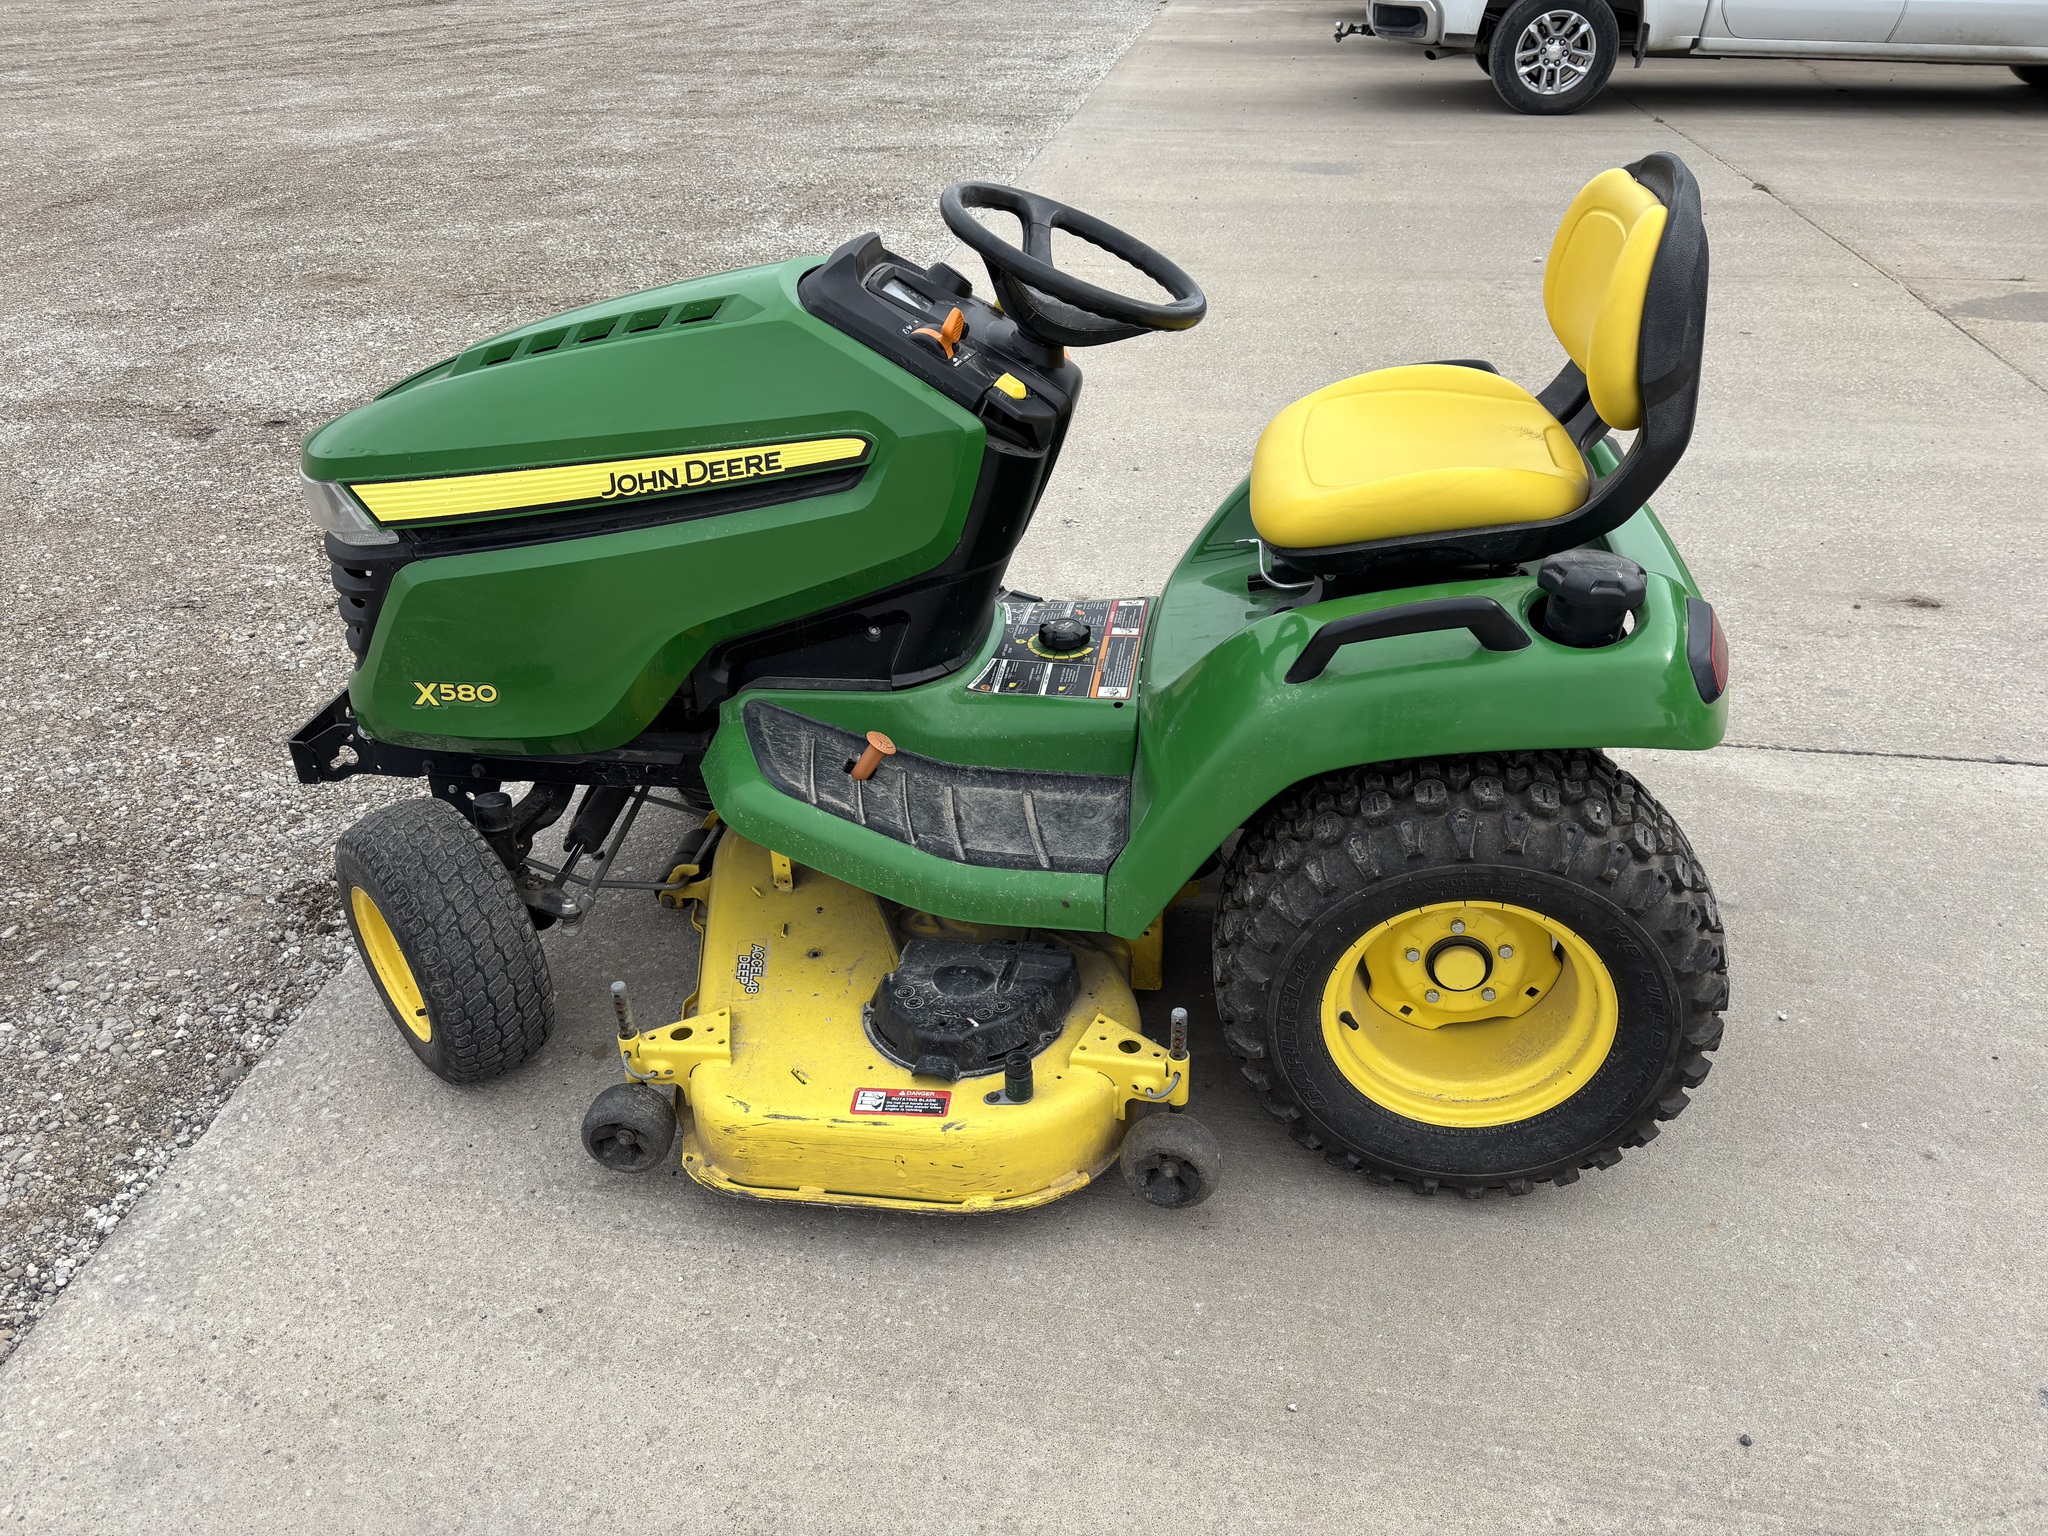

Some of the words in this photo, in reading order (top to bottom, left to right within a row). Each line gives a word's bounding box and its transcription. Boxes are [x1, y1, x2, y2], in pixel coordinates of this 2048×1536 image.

[601, 467, 679, 497] JOHN
[684, 450, 782, 484] DEERE
[412, 680, 498, 707] X580
[736, 955, 750, 985] DEEP
[1279, 954, 1329, 1110] CARLISLE
